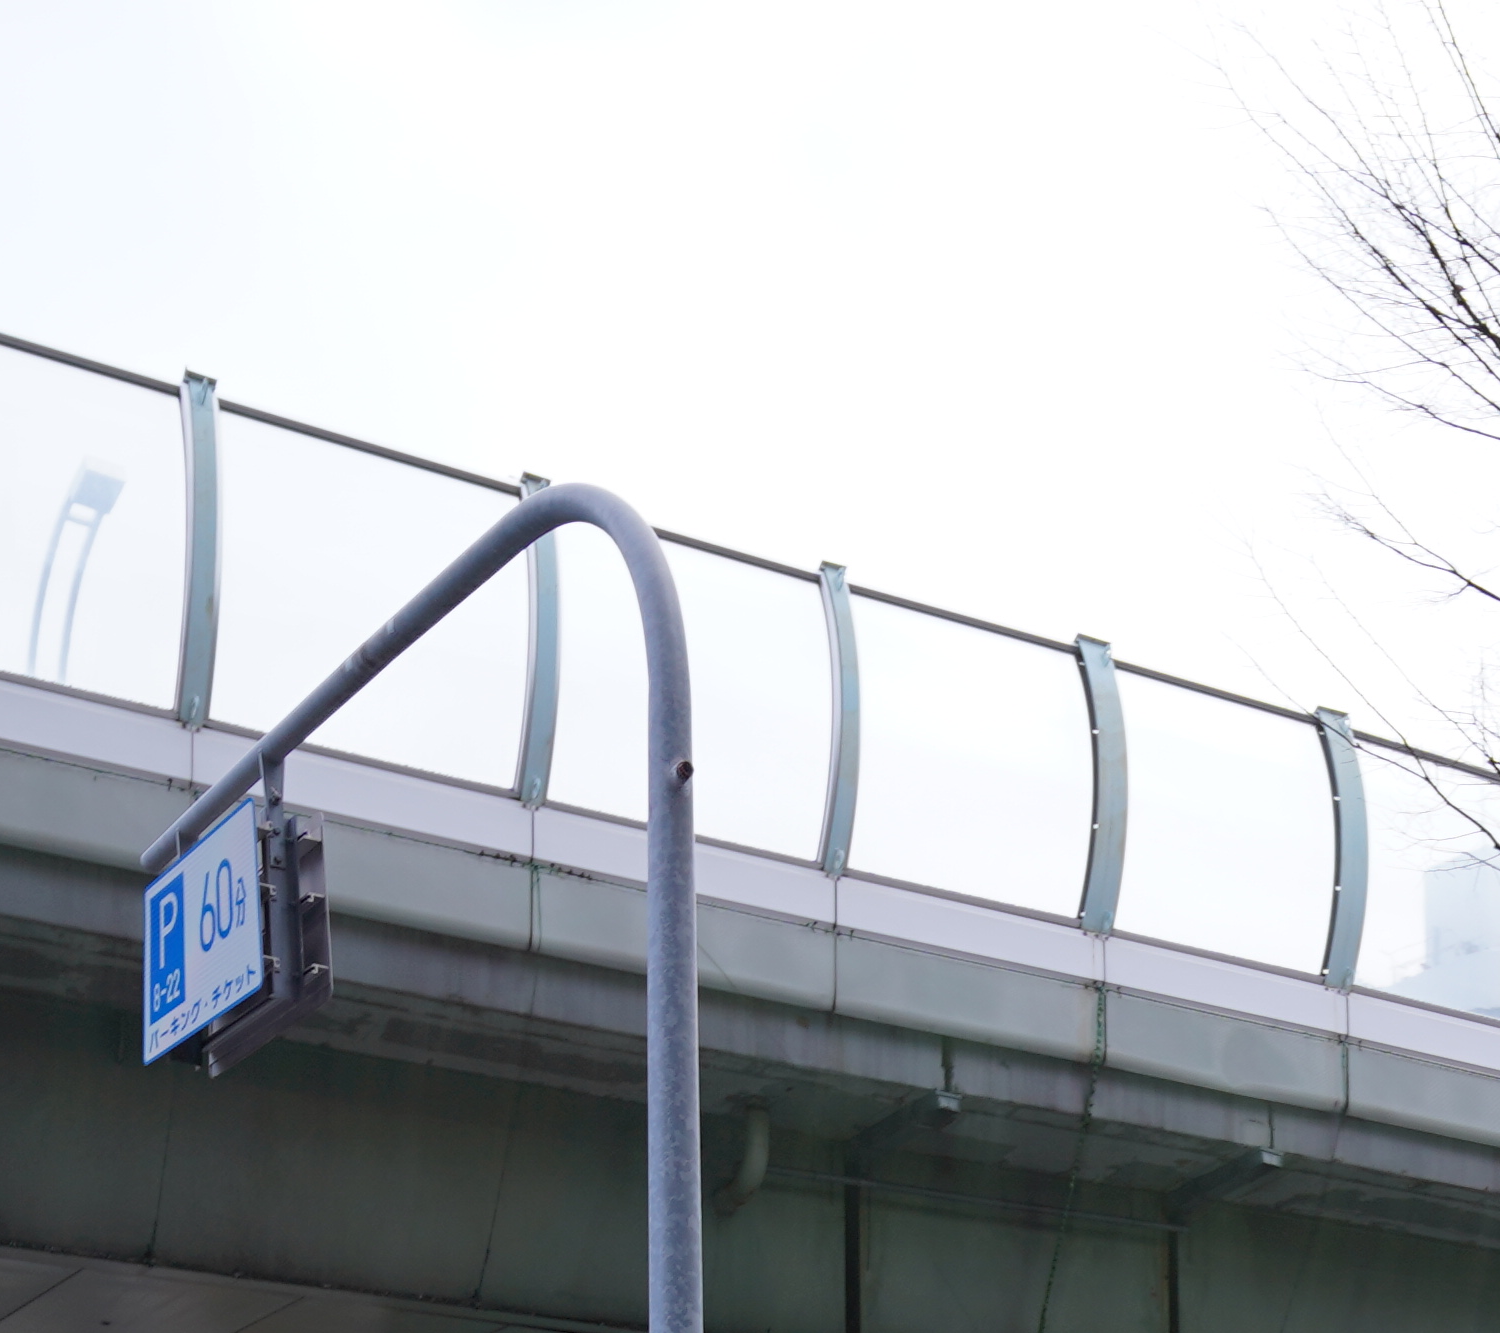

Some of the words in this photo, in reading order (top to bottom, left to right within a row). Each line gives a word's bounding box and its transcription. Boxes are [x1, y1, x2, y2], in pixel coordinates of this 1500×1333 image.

[159, 891, 179, 969] P
[200, 858, 247, 952] 60分
[150, 967, 257, 1054] パーキング・チケット
[153, 970, 181, 1013] 8-22
